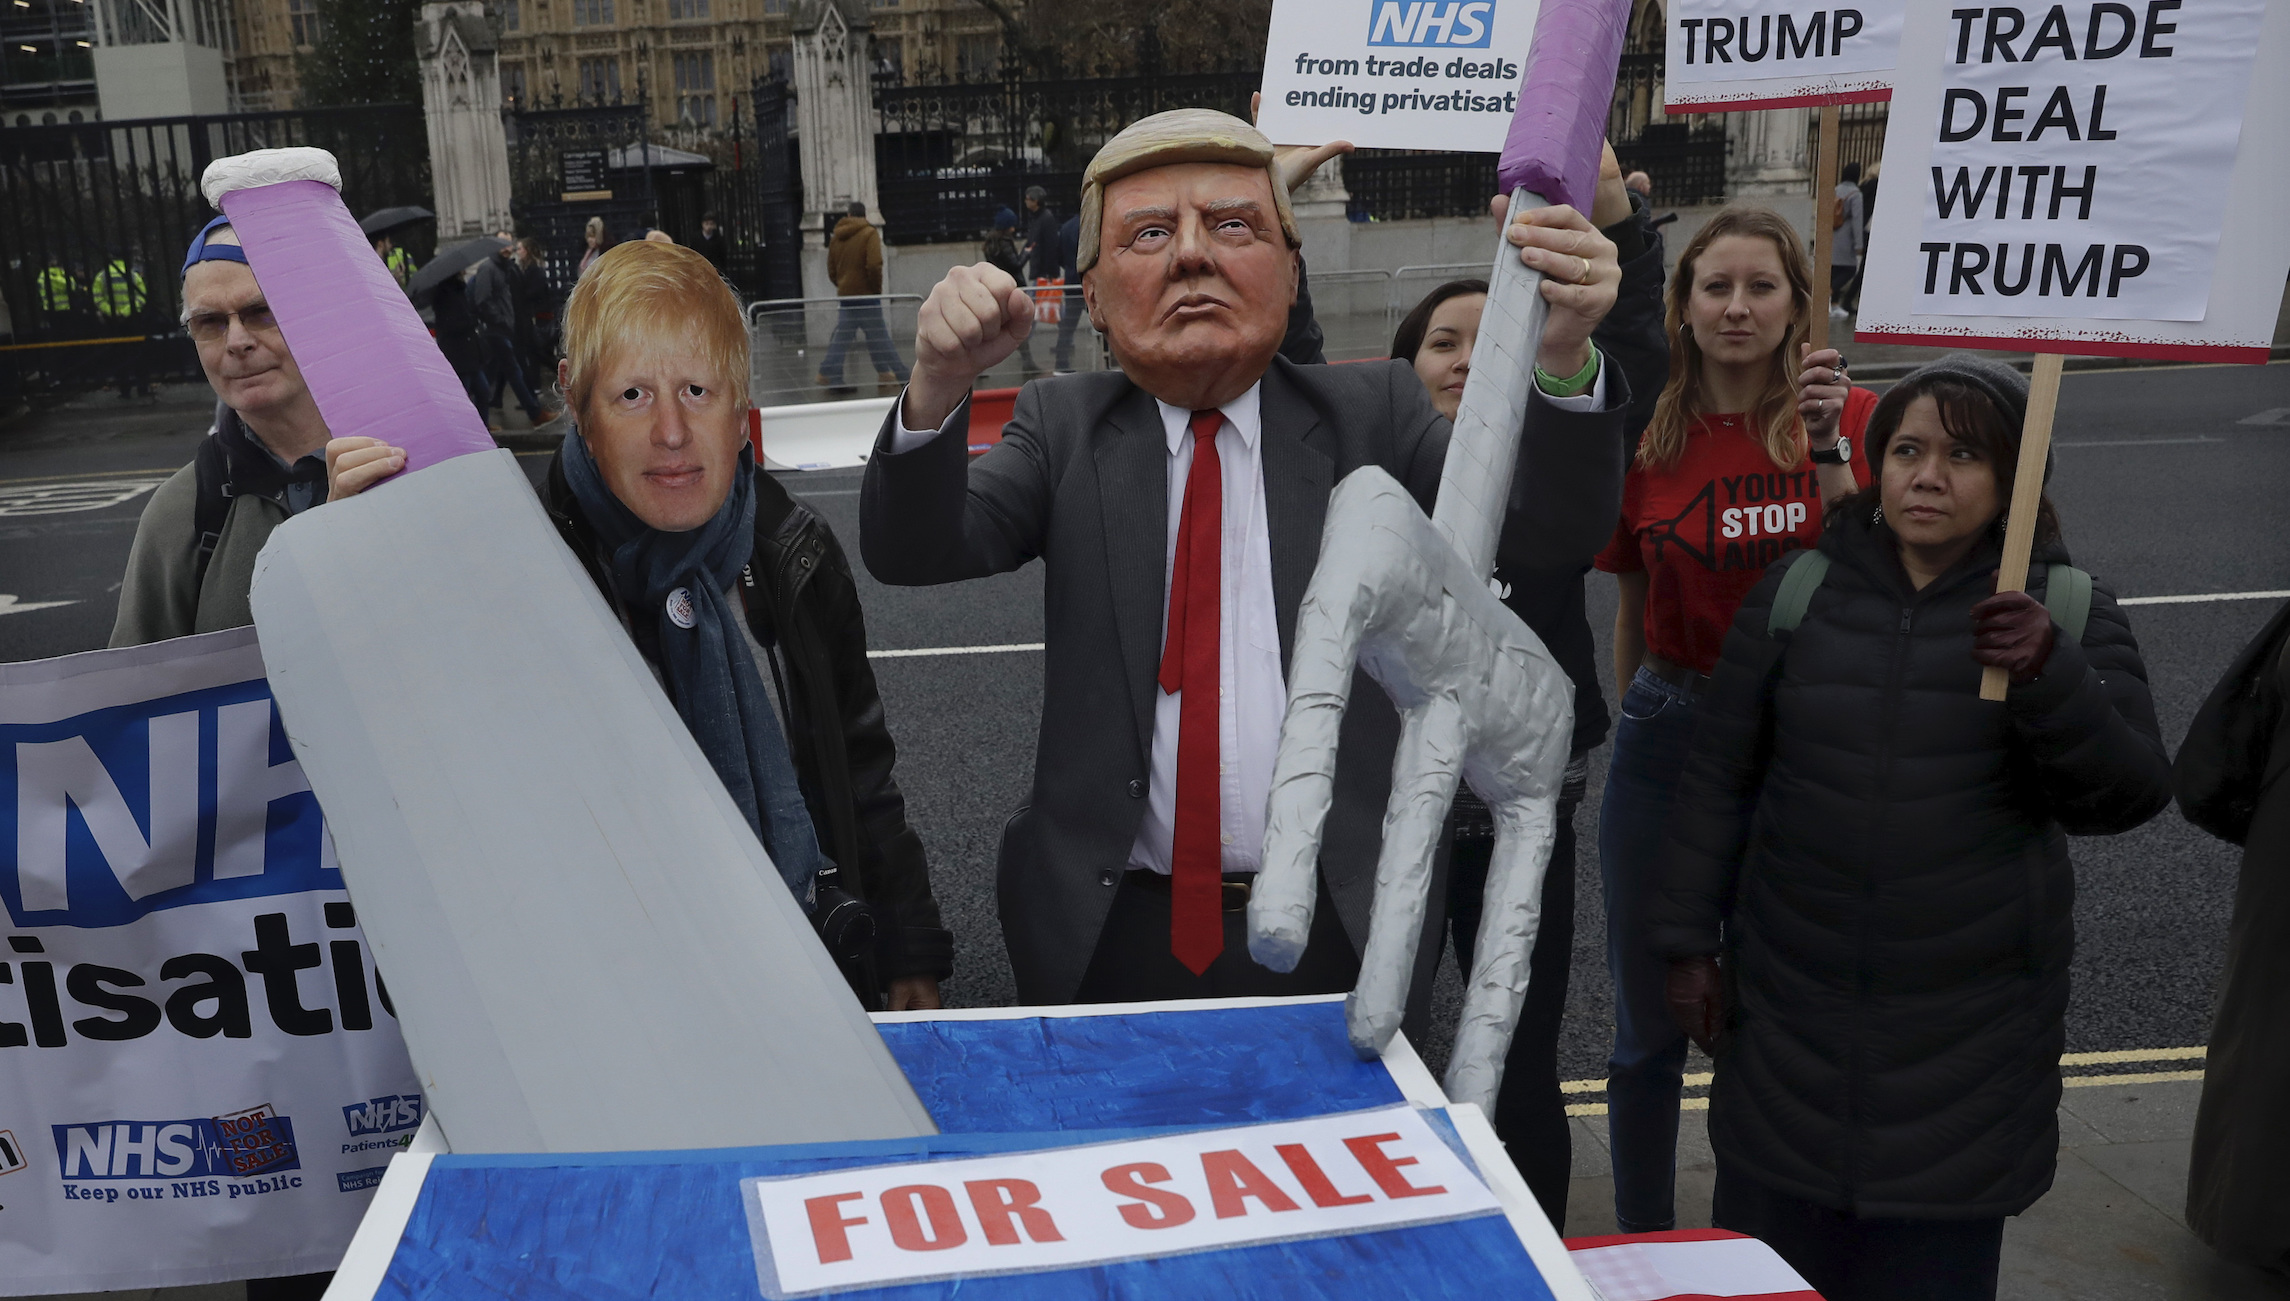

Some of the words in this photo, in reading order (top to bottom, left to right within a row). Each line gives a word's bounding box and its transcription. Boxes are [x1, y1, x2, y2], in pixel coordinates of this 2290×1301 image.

[1370, 1, 1492, 45] NHS
[1680, 9, 1864, 65] TRUMP
[1951, 0, 2183, 64] TRADE
[1295, 52, 1359, 76] from
[1365, 55, 1439, 78] trade
[1445, 57, 1518, 80] deals
[1285, 86, 1377, 115] ending
[1381, 88, 1520, 115] privatisat
[1939, 84, 2118, 143] DEAL
[1931, 165, 2097, 220] WITH
[1920, 242, 2151, 298] TRUMP
[1721, 502, 1807, 538] STOP
[220, 1111, 267, 1138] NOT
[349, 1099, 419, 1132] NHS
[65, 1124, 195, 1176] NHS
[229, 1129, 278, 1155] FOR
[233, 1142, 288, 1172] SALE
[63, 1184, 119, 1203] Keep
[127, 1186, 164, 1200] our
[172, 1179, 221, 1198] NHS
[228, 1175, 303, 1199] public
[342, 1179, 364, 1190] NHS
[804, 1178, 1067, 1265] FOR
[1100, 1131, 1449, 1230] SALE
